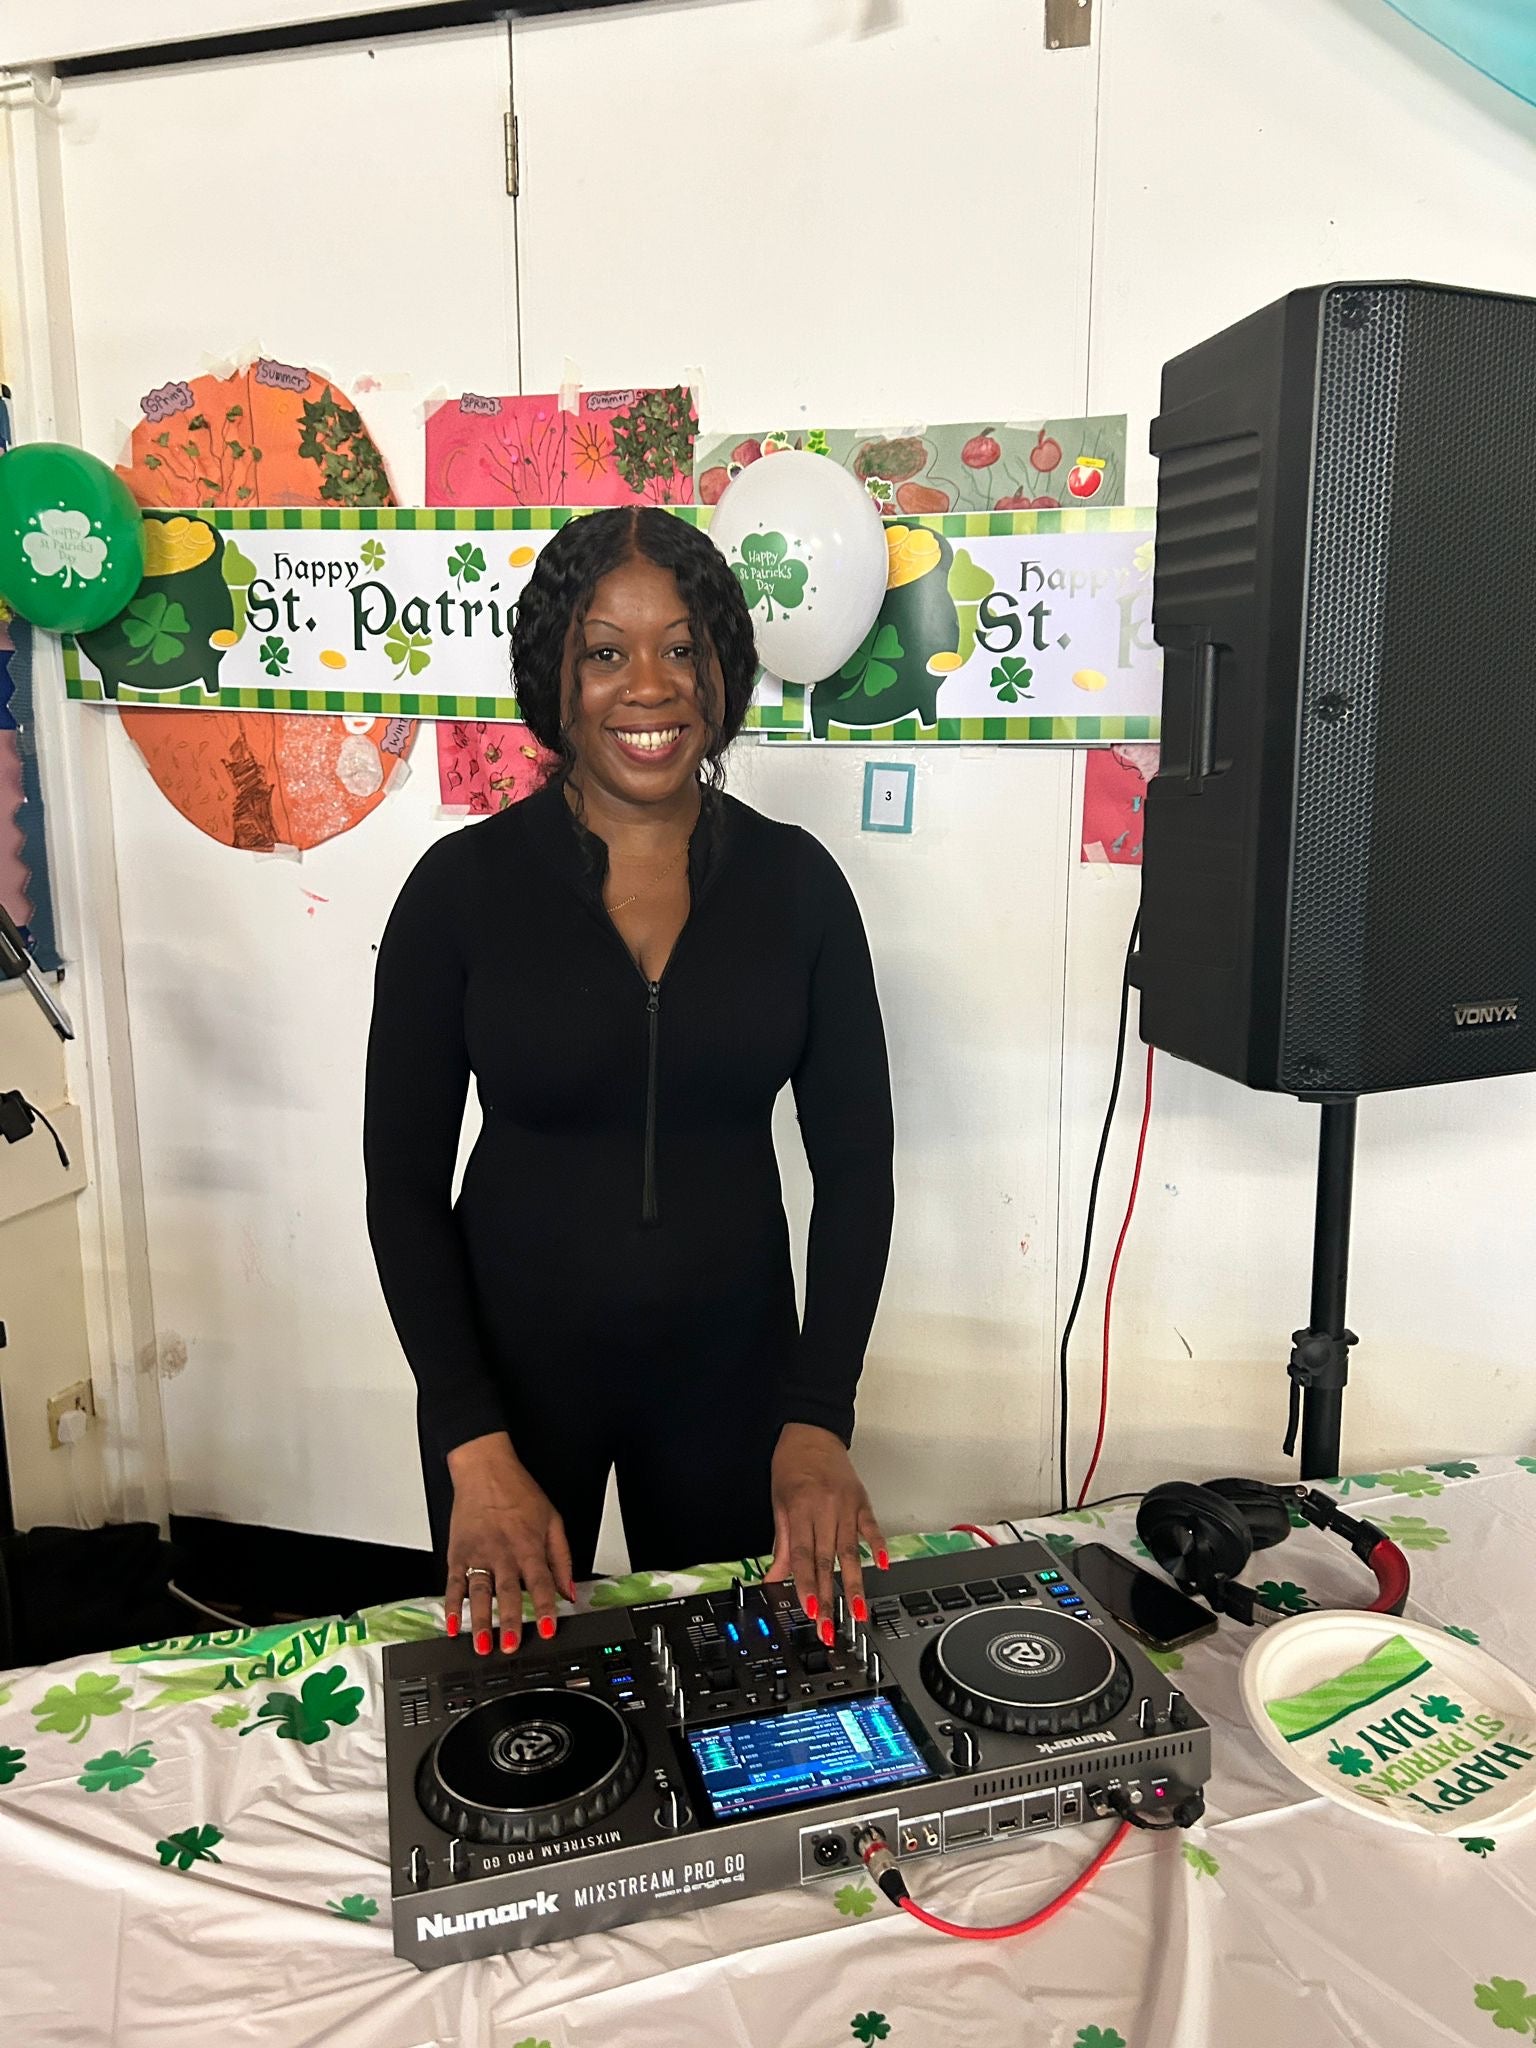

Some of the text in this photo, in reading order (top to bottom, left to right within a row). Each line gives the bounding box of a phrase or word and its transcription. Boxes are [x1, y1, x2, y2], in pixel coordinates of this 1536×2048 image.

[273, 552, 359, 588] Happy
[739, 563, 792, 580] St Patrick's
[748, 550, 779, 567] Happy
[755, 579, 775, 595] Day
[246, 578, 318, 633] St.
[975, 591, 1072, 653] St.
[885, 790, 892, 801] 3
[1454, 1004, 1519, 1026] VONYX
[1035, 1730, 1118, 1754] Numark
[1356, 1707, 1439, 1762] DAY
[1456, 1714, 1505, 1741] ST.
[1407, 1741, 1535, 1814] HAPPY
[482, 1831, 622, 1870] MIXSTREAM PRO GO
[574, 1853, 745, 1907] MIXSTREAM PRO GO
[416, 1890, 560, 1942] Numark
